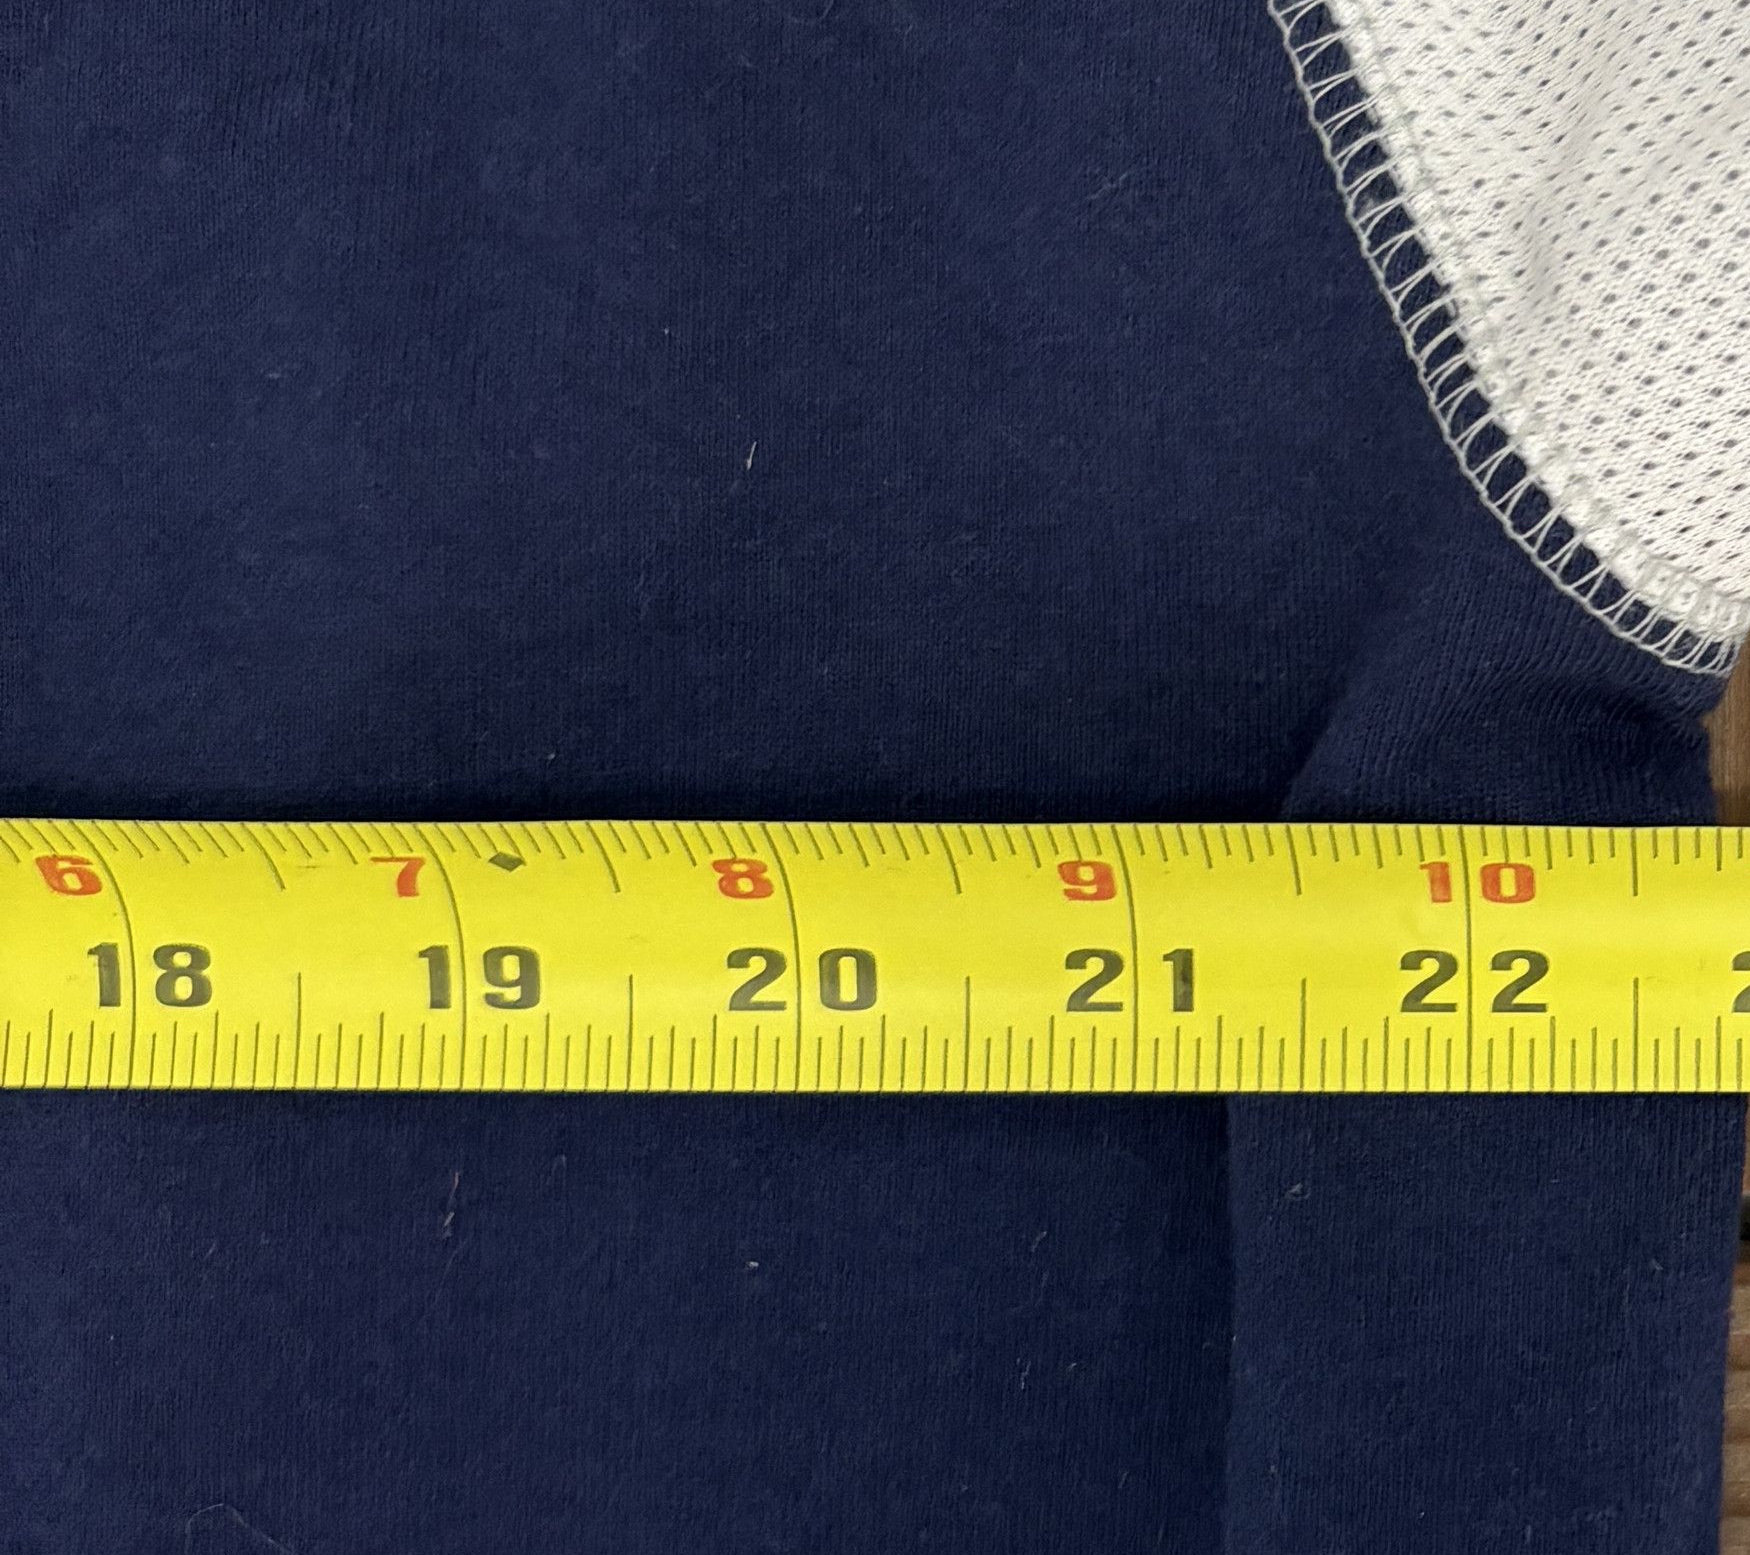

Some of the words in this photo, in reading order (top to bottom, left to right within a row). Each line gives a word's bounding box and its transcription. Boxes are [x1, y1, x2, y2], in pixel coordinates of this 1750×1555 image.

[34, 855, 104, 897] 6
[371, 856, 427, 898] 7
[712, 858, 774, 899] 8
[1058, 860, 1117, 902] 9
[1420, 862, 1536, 904] 10
[87, 942, 212, 1009] 18
[419, 945, 541, 1010] 19
[726, 947, 878, 1011] 20
[1064, 948, 1195, 1013] 21
[1400, 949, 1550, 1013] 22
